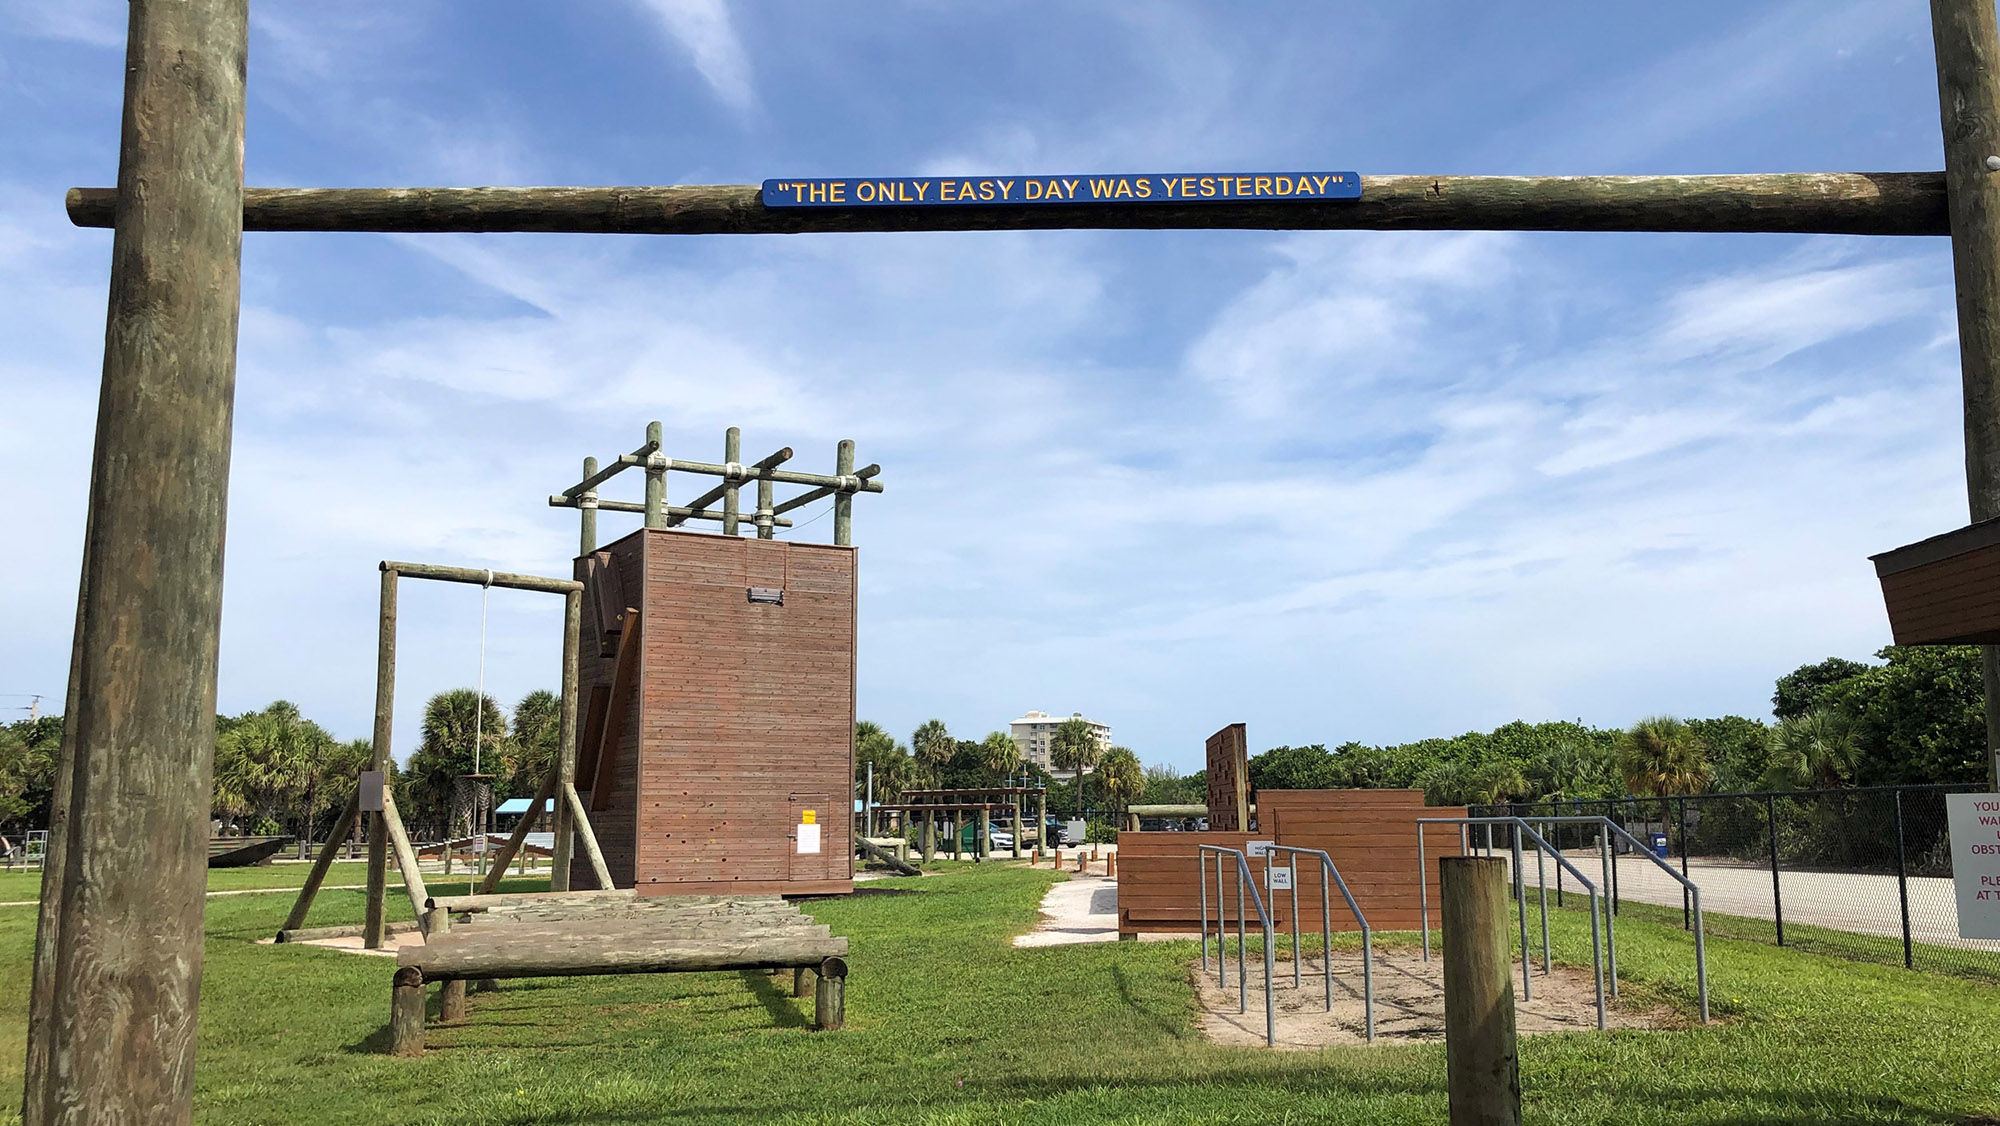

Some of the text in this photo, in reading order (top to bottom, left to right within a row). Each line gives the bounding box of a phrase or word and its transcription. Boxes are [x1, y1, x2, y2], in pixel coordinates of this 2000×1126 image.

[778, 175, 1344, 203] "THE ONLY EASY DAY WAS YESTERDAY"
[1978, 816, 2000, 826] WA
[1976, 890, 1991, 900] AT
